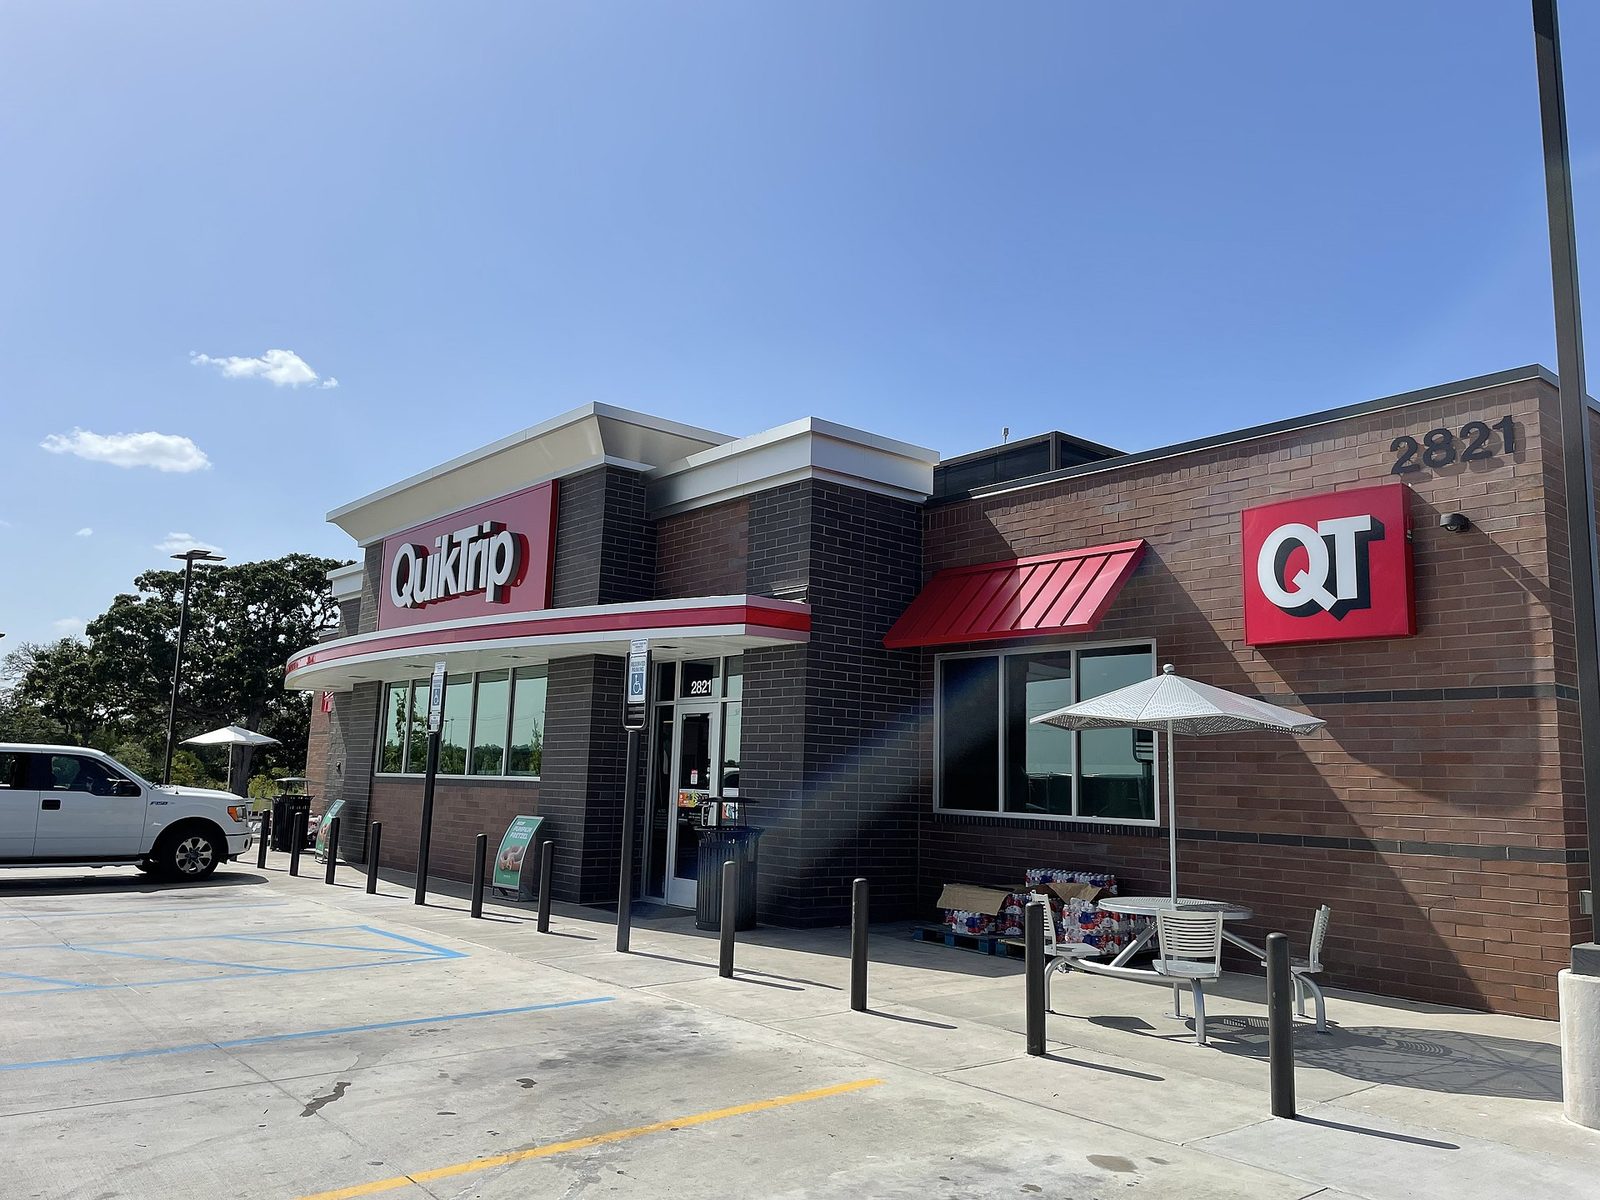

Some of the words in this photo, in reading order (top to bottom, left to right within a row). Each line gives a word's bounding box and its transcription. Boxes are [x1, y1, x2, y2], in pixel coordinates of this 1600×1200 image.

[1390, 415, 1518, 476] 2821
[390, 520, 519, 609] QuikTrip
[1257, 514, 1375, 614] QT
[691, 680, 712, 694] 2821
